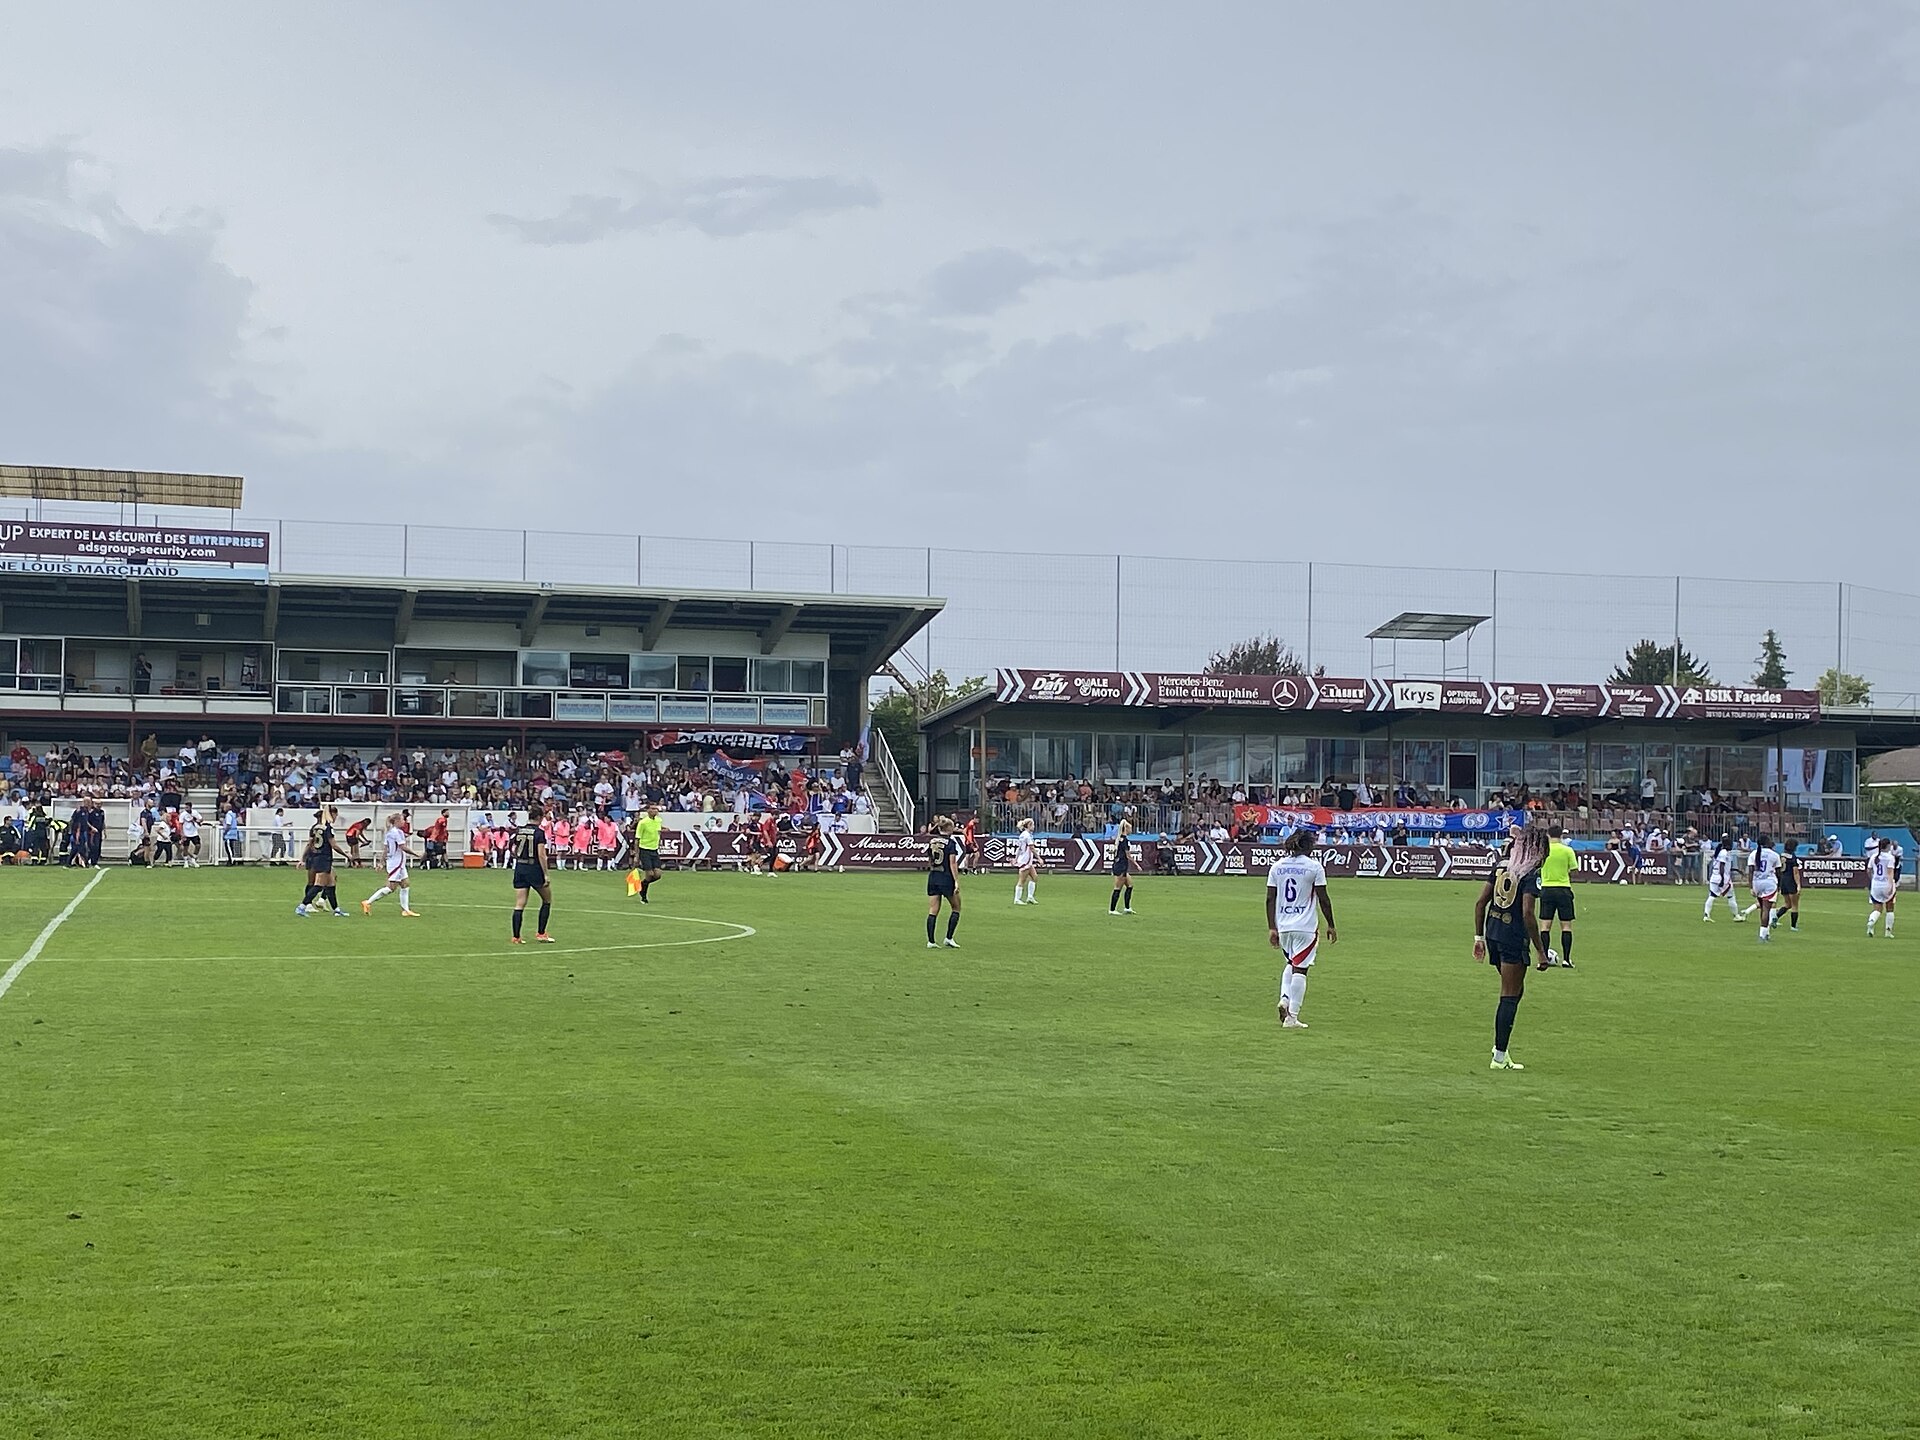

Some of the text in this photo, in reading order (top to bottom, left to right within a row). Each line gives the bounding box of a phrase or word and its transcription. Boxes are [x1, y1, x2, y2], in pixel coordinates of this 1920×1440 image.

[29, 528, 264, 548] EXPERT DE LA SÉCURITÉ DES ENTREPRISES
[78, 541, 216, 558] adsgroup-security.com
[21, 563, 72, 573] LOUIS
[77, 565, 179, 577] MARCHAND
[1032, 677, 1068, 694] Dafy
[1158, 676, 1224, 687] Mercedes-Benz
[1091, 688, 1120, 697] MOTO
[1191, 688, 1205, 697] du
[1208, 687, 1259, 700] Dauphiné
[1400, 687, 1435, 704] Krys
[1446, 690, 1478, 698] OPTIQUE
[1705, 689, 1782, 705] ISIK Façades
[1448, 697, 1482, 705] AUDITION
[1331, 812, 1446, 829] FENOTTES
[1462, 813, 1489, 829] 69
[516, 834, 534, 858] 71
[849, 837, 896, 849] Maison
[1006, 838, 1047, 847] FRCE
[1006, 846, 1065, 857] MARIAUX
[1251, 849, 1272, 857] TOUS
[1453, 857, 1492, 865] BONNAIRE
[1804, 860, 1866, 871] FERMETURES
[1627, 867, 1667, 875] FANCES
[1285, 878, 1297, 902] 6
